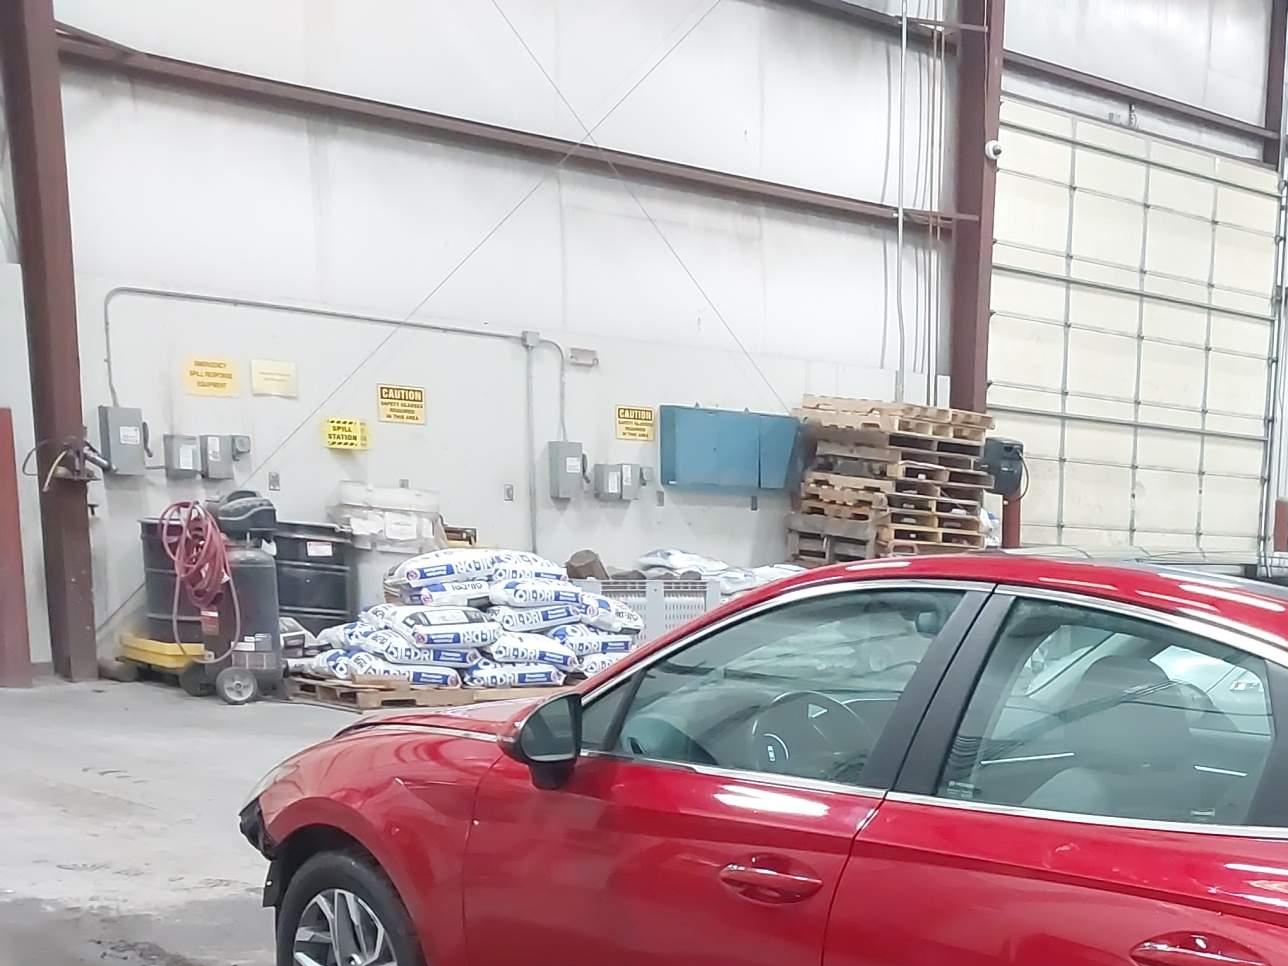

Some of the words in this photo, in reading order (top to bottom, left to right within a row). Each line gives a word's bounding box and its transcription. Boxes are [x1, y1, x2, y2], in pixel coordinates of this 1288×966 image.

[382, 388, 422, 401] CAUTION
[620, 409, 652, 420] CAUTION
[332, 425, 353, 433] SPILL
[328, 433, 358, 441] STATION
